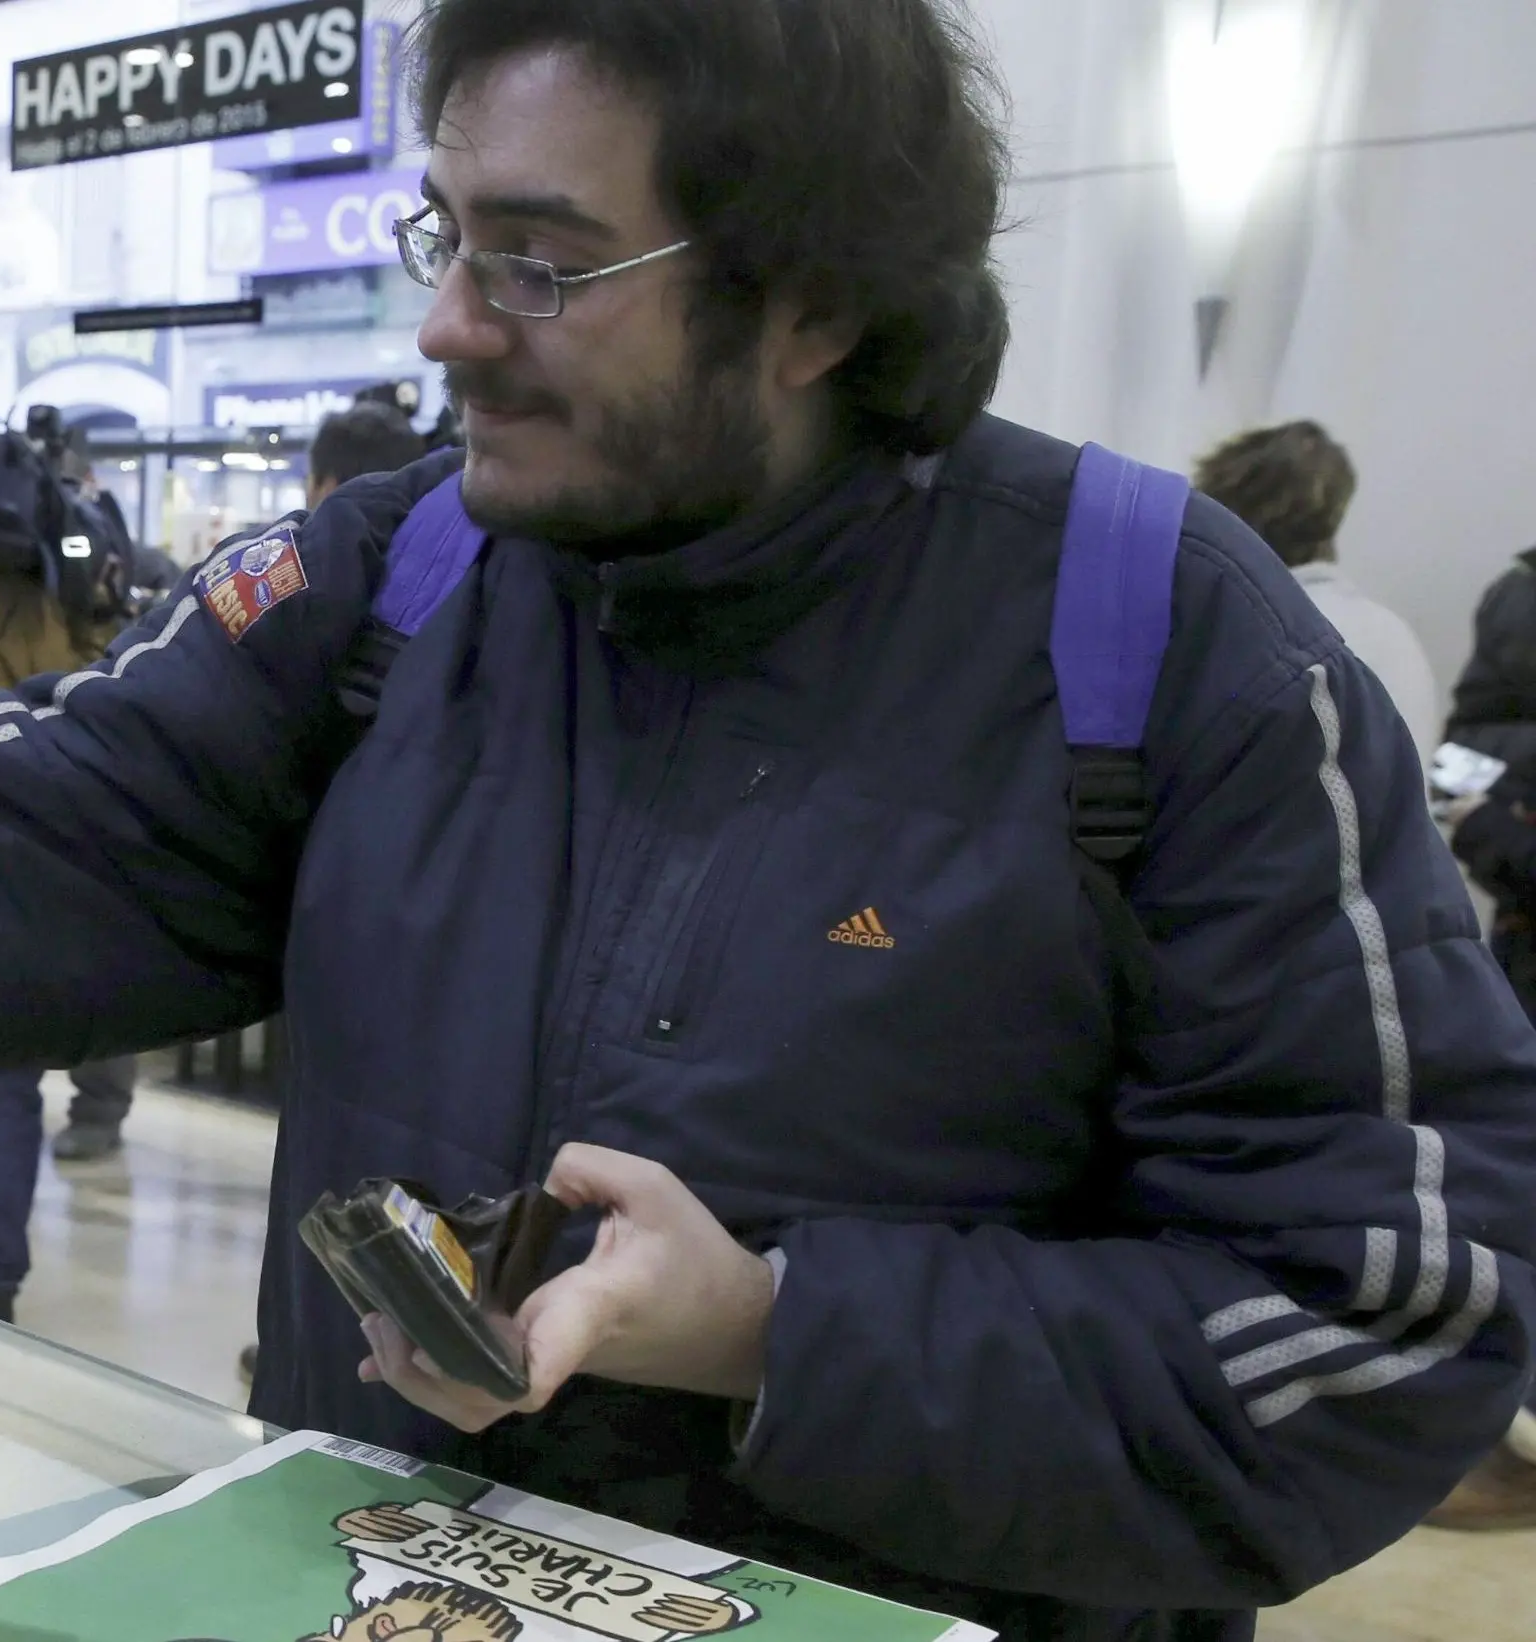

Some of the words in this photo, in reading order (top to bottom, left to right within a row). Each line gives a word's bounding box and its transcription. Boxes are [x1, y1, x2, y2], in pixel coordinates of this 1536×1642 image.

[16, 38, 192, 131] HAPPY
[204, 6, 357, 98] DAYS
[83, 130, 96, 153] 2
[98, 126, 123, 151] de
[190, 112, 217, 138] de
[218, 100, 267, 132] 2015
[827, 929, 896, 949] adidas
[531, 1577, 610, 1612] JE
